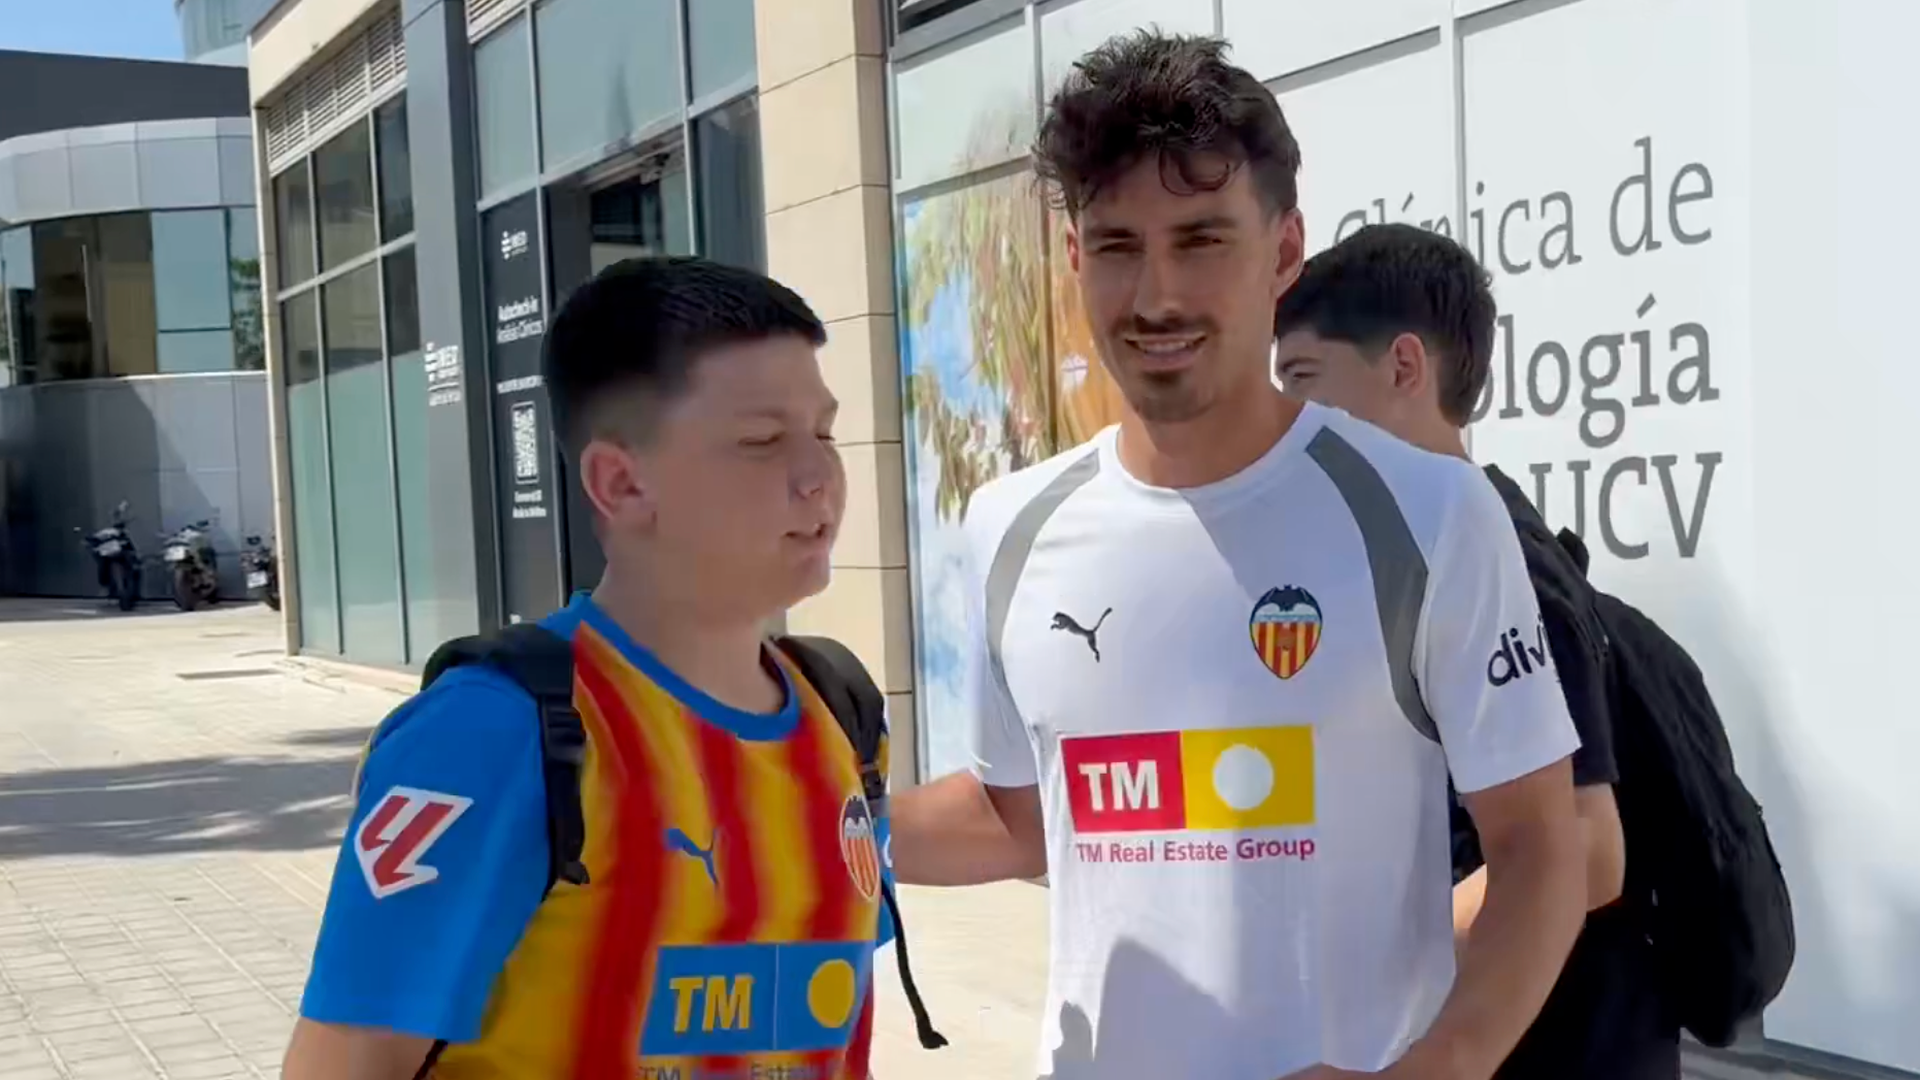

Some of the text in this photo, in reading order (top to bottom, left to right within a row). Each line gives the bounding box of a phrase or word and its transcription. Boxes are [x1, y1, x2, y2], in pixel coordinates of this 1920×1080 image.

[1334, 136, 1714, 275] Cica de
[1528, 451, 1723, 560] UCV
[1078, 759, 1160, 812] TM
[1076, 838, 1316, 863] TM Real Estate Group
[668, 974, 755, 1034] TM
